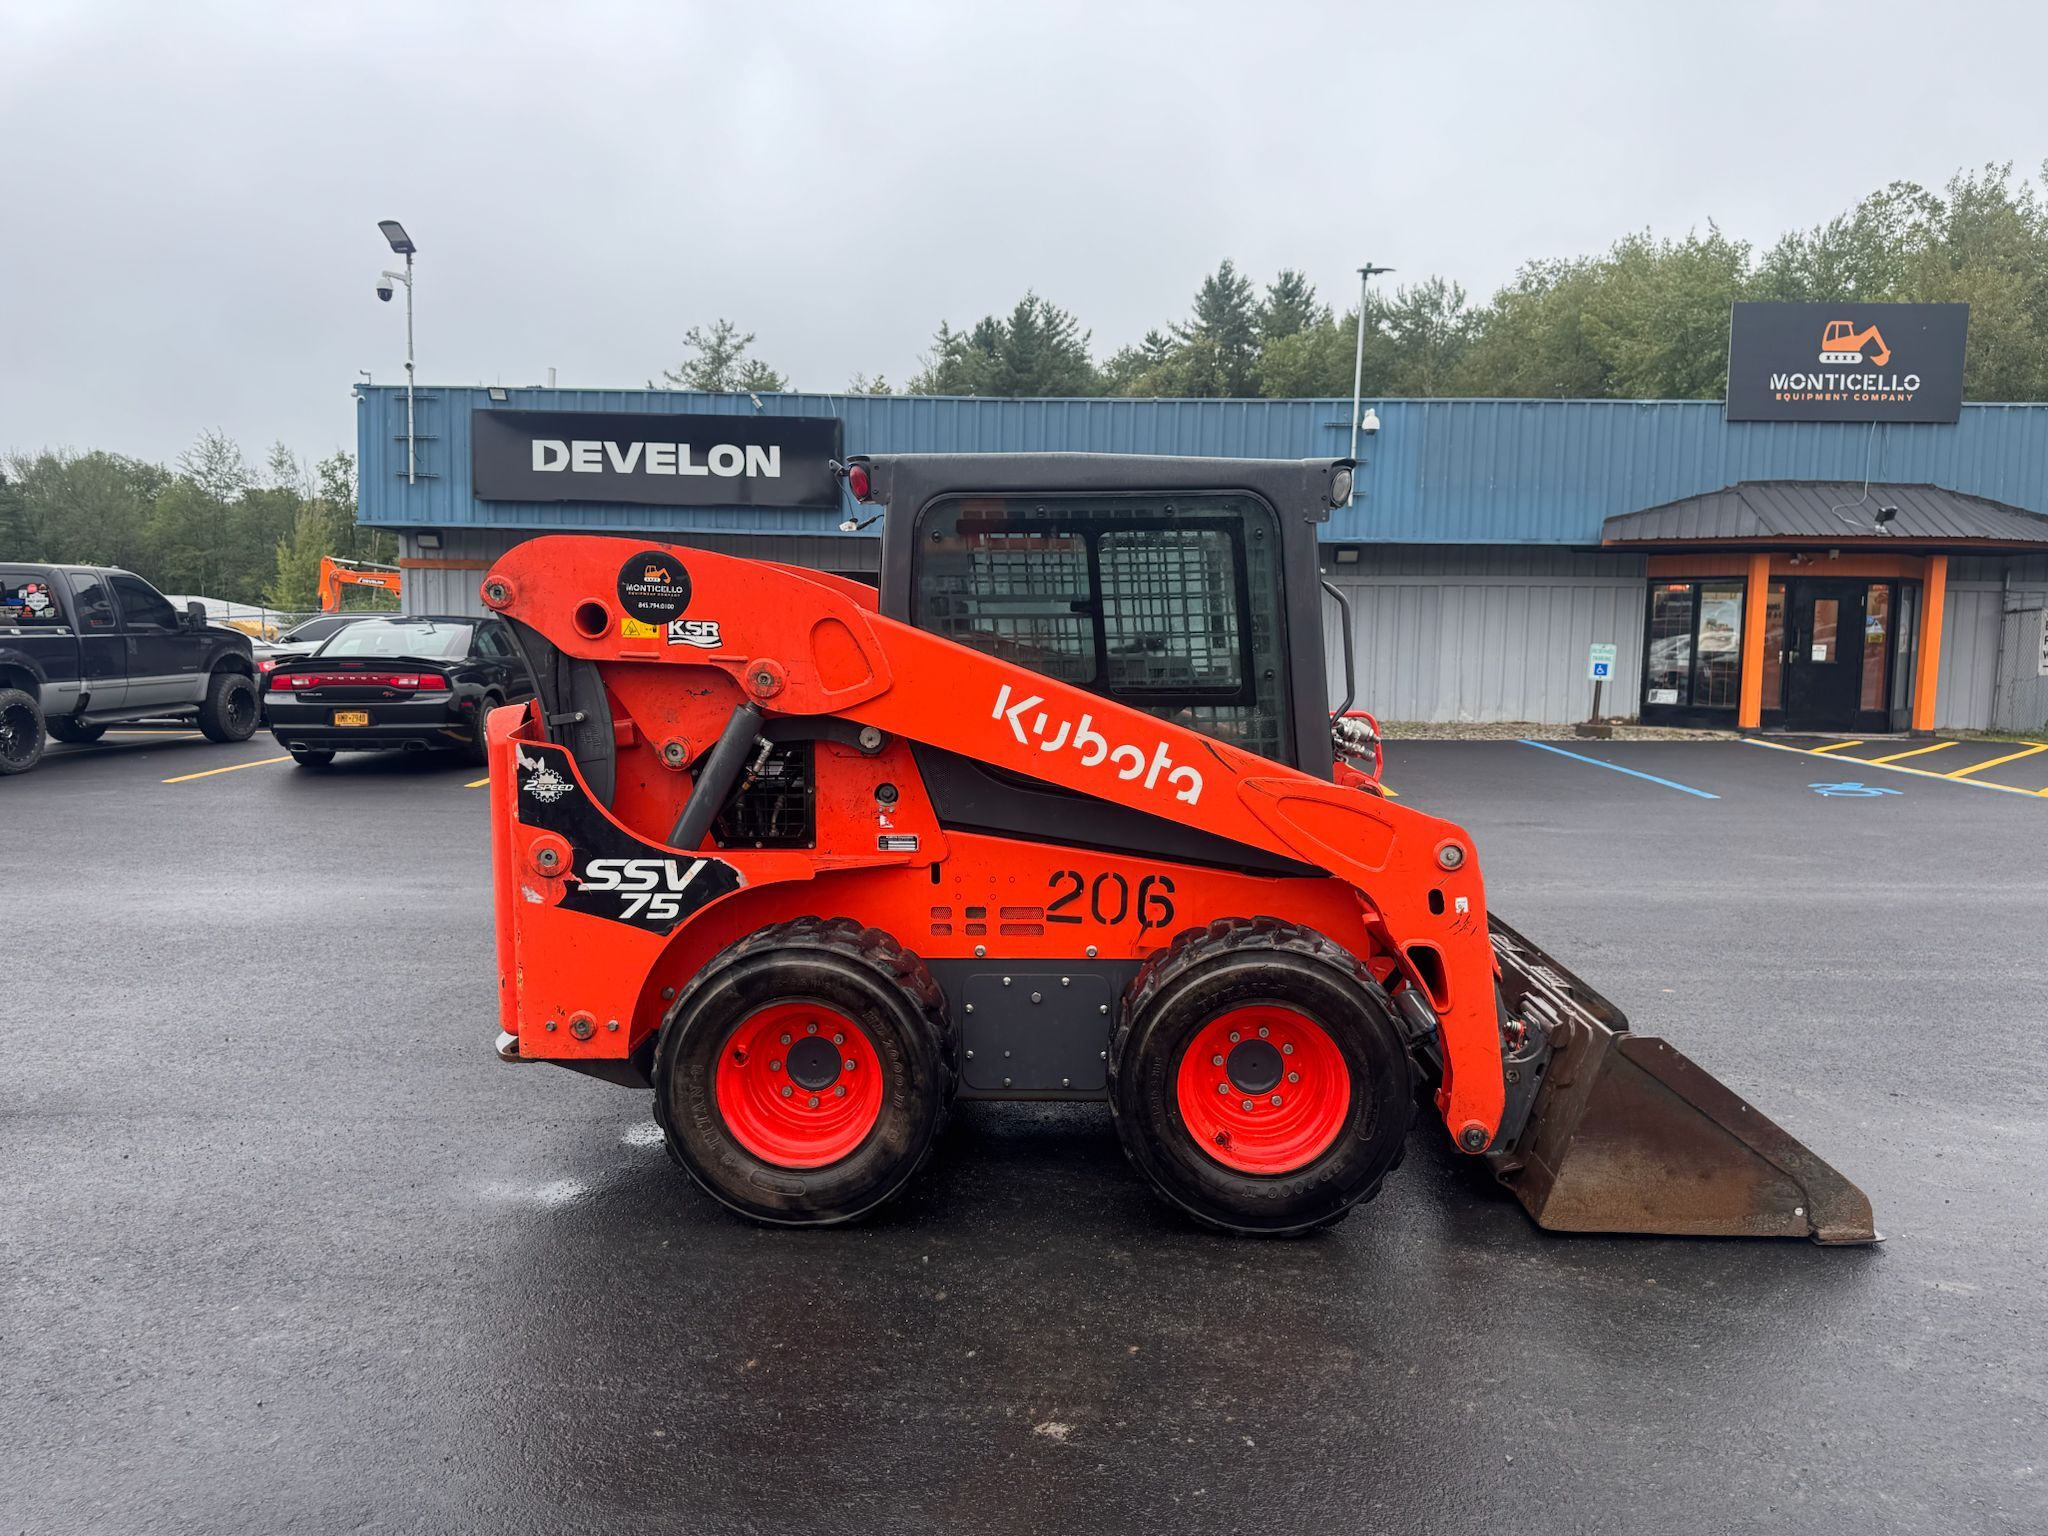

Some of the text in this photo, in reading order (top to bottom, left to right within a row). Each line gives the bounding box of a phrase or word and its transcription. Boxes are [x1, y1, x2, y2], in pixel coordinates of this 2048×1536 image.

[1769, 373, 1921, 391] MONTICELLO
[1775, 392, 1914, 402] EQUIPMENT COMPANY
[532, 439, 781, 478] DEVELON
[625, 583, 684, 594] MONTICELLO
[667, 620, 720, 637] KSR
[991, 684, 1204, 806] Kubota
[578, 858, 709, 891] SSV
[618, 892, 683, 920] 75
[1046, 870, 1176, 928] 206
